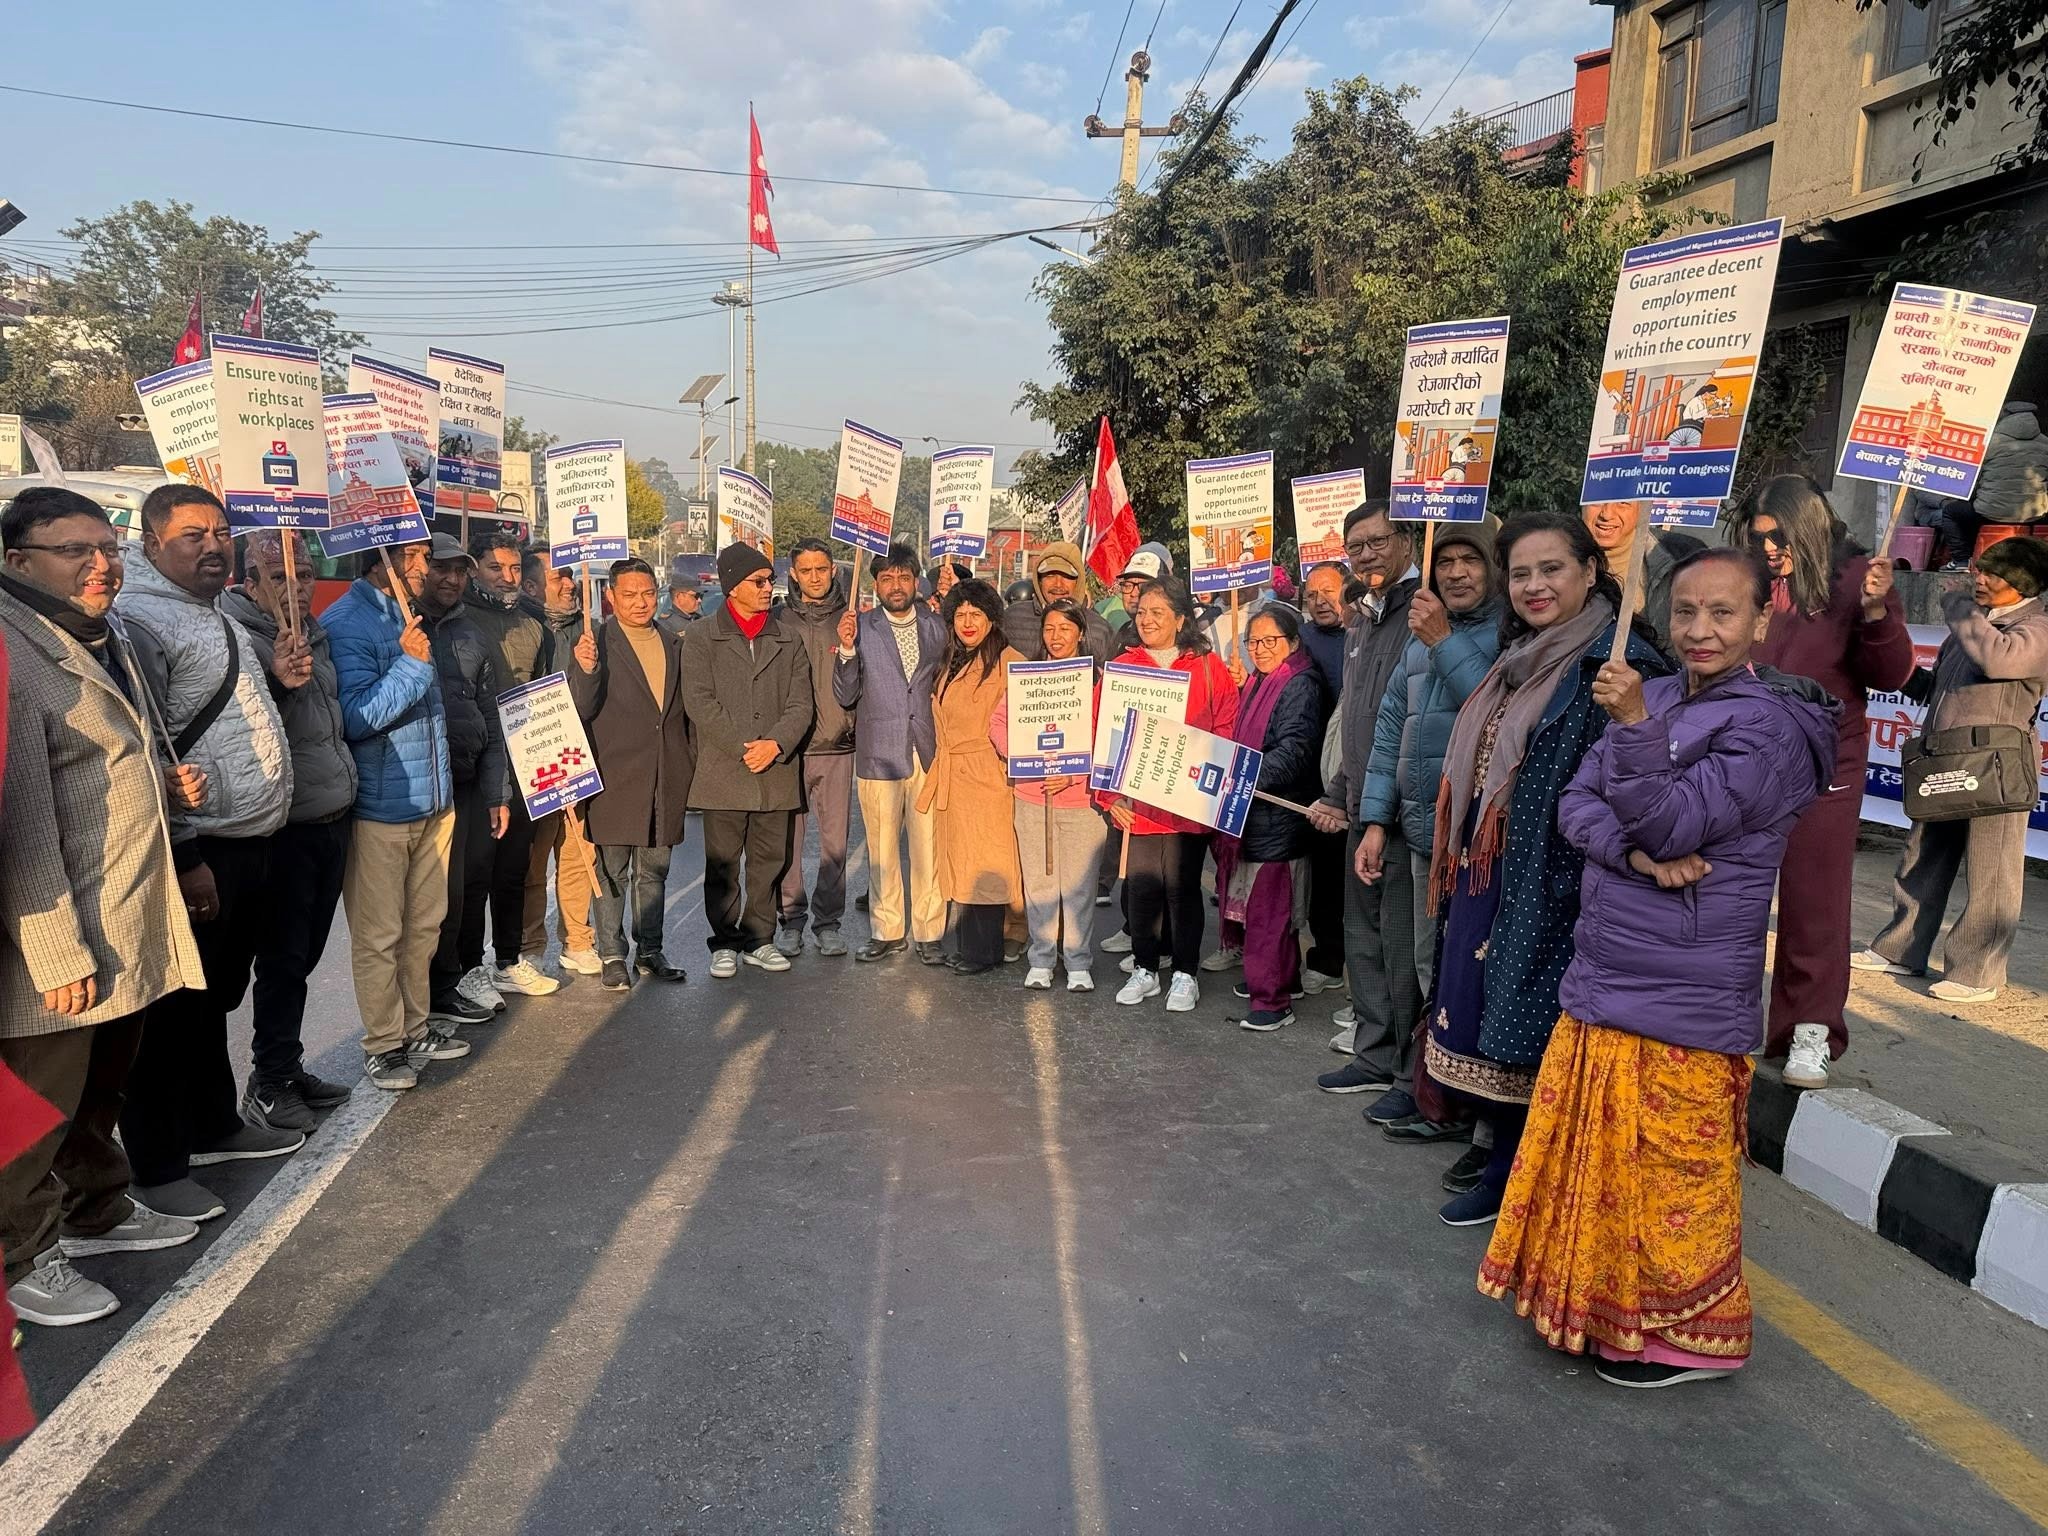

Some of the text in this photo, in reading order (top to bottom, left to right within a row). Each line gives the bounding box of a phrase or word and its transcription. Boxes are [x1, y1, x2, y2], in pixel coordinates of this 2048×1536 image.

[1629, 256, 1763, 291] Guarantee decent
[1642, 284, 1737, 311] employment
[1633, 308, 1737, 337] opportunities
[1894, 311, 2022, 341] प्रवासी र आश्रित
[1614, 332, 1751, 360] within the country
[1960, 336, 2013, 355] सामाजिक
[1410, 346, 1499, 369] स्वदेशमै मर्यादित
[1952, 350, 1997, 368] राज्यको
[226, 361, 276, 382] Ensure
[278, 371, 318, 390] voting
[1418, 372, 1482, 392] रोजगारीको
[1900, 373, 1952, 390] सुनिश्चित
[151, 382, 208, 407] Guarantee
[372, 375, 422, 399] Immediately
[444, 381, 492, 402] रोजगारीलाई
[248, 388, 304, 407] rights at
[410, 400, 424, 410] the
[404, 409, 429, 424] health
[465, 403, 471, 413] र
[473, 404, 502, 419] मर्यादित
[1407, 399, 1451, 417] ग्यारेण्टी
[1455, 402, 1476, 416] गर
[172, 414, 217, 435] opportu
[238, 411, 314, 431] workplaces
[400, 421, 429, 436] fees for
[166, 430, 219, 454] within the
[410, 438, 436, 451] abroad
[1856, 450, 1902, 467] नेपाल ट्रेड
[1195, 468, 1267, 484] Guarantee decent
[1589, 464, 1730, 481] Nepal Trade Union Congress
[1898, 470, 1926, 484] NTUC
[1206, 483, 1257, 496] employment
[1636, 482, 1671, 494] NTUC
[1204, 495, 1259, 509] opportunities
[1396, 493, 1422, 504] नेपाल ट्रेड
[230, 504, 253, 513] Nepal
[301, 506, 328, 515] Congress
[690, 512, 706, 520] BCA
[1195, 505, 1268, 521] within the country
[1422, 506, 1447, 516] NTUC
[277, 516, 300, 524] NTUC
[330, 528, 366, 542] नेपाल ट्रेड
[370, 534, 394, 545] NTUC
[1247, 566, 1270, 574] Congress
[1228, 579, 1245, 587] NTUC
[1026, 686, 1076, 699] श्रमिकलाई
[1111, 680, 1184, 702] Ensure voting
[1019, 698, 1082, 711] मताधिकारको
[1156, 704, 1167, 713] at
[1018, 714, 1054, 724] व्यवस्था
[1129, 717, 1159, 790] Ensure voting
[1150, 736, 1170, 782] rights at
[1164, 733, 1187, 795] workplaces
[1225, 813, 1233, 830] Nepal
[1229, 796, 1239, 812] Trade
[1240, 750, 1251, 778] Congress
[1242, 780, 1253, 800] NTUC
